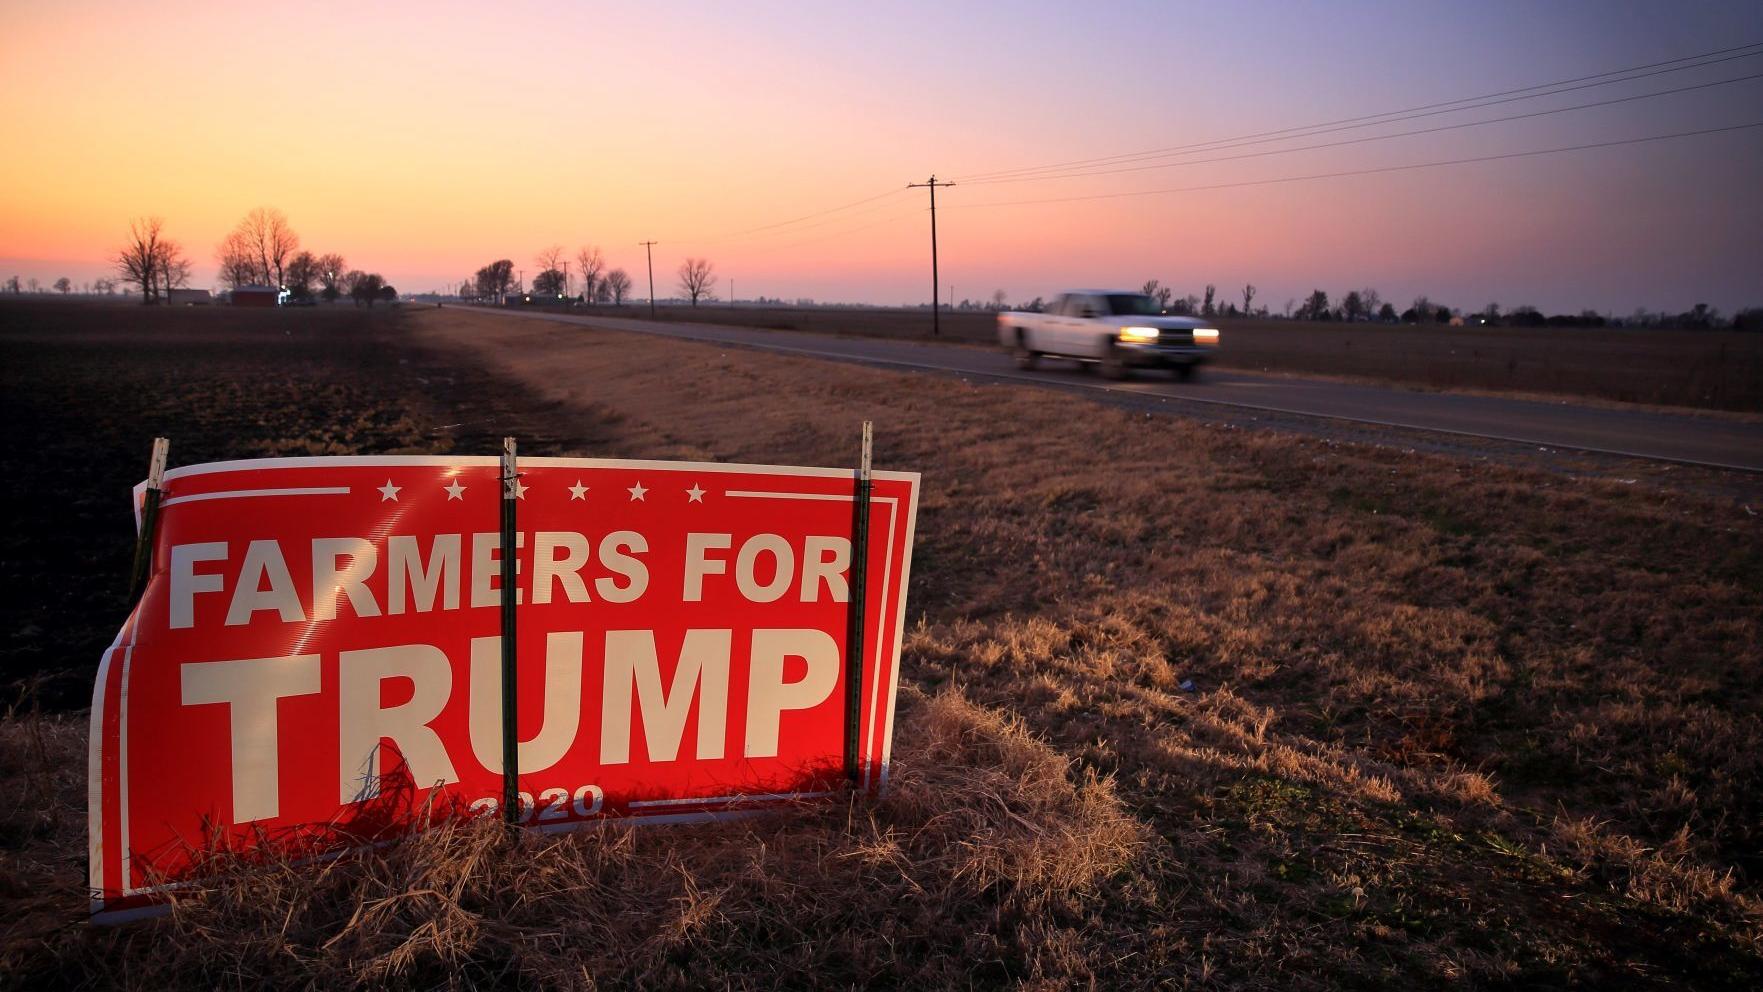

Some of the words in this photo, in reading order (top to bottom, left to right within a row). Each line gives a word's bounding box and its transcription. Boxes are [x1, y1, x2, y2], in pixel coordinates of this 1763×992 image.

[169, 531, 650, 629] FARMERS
[683, 533, 853, 603] FOR
[181, 628, 841, 824] TRUMP
